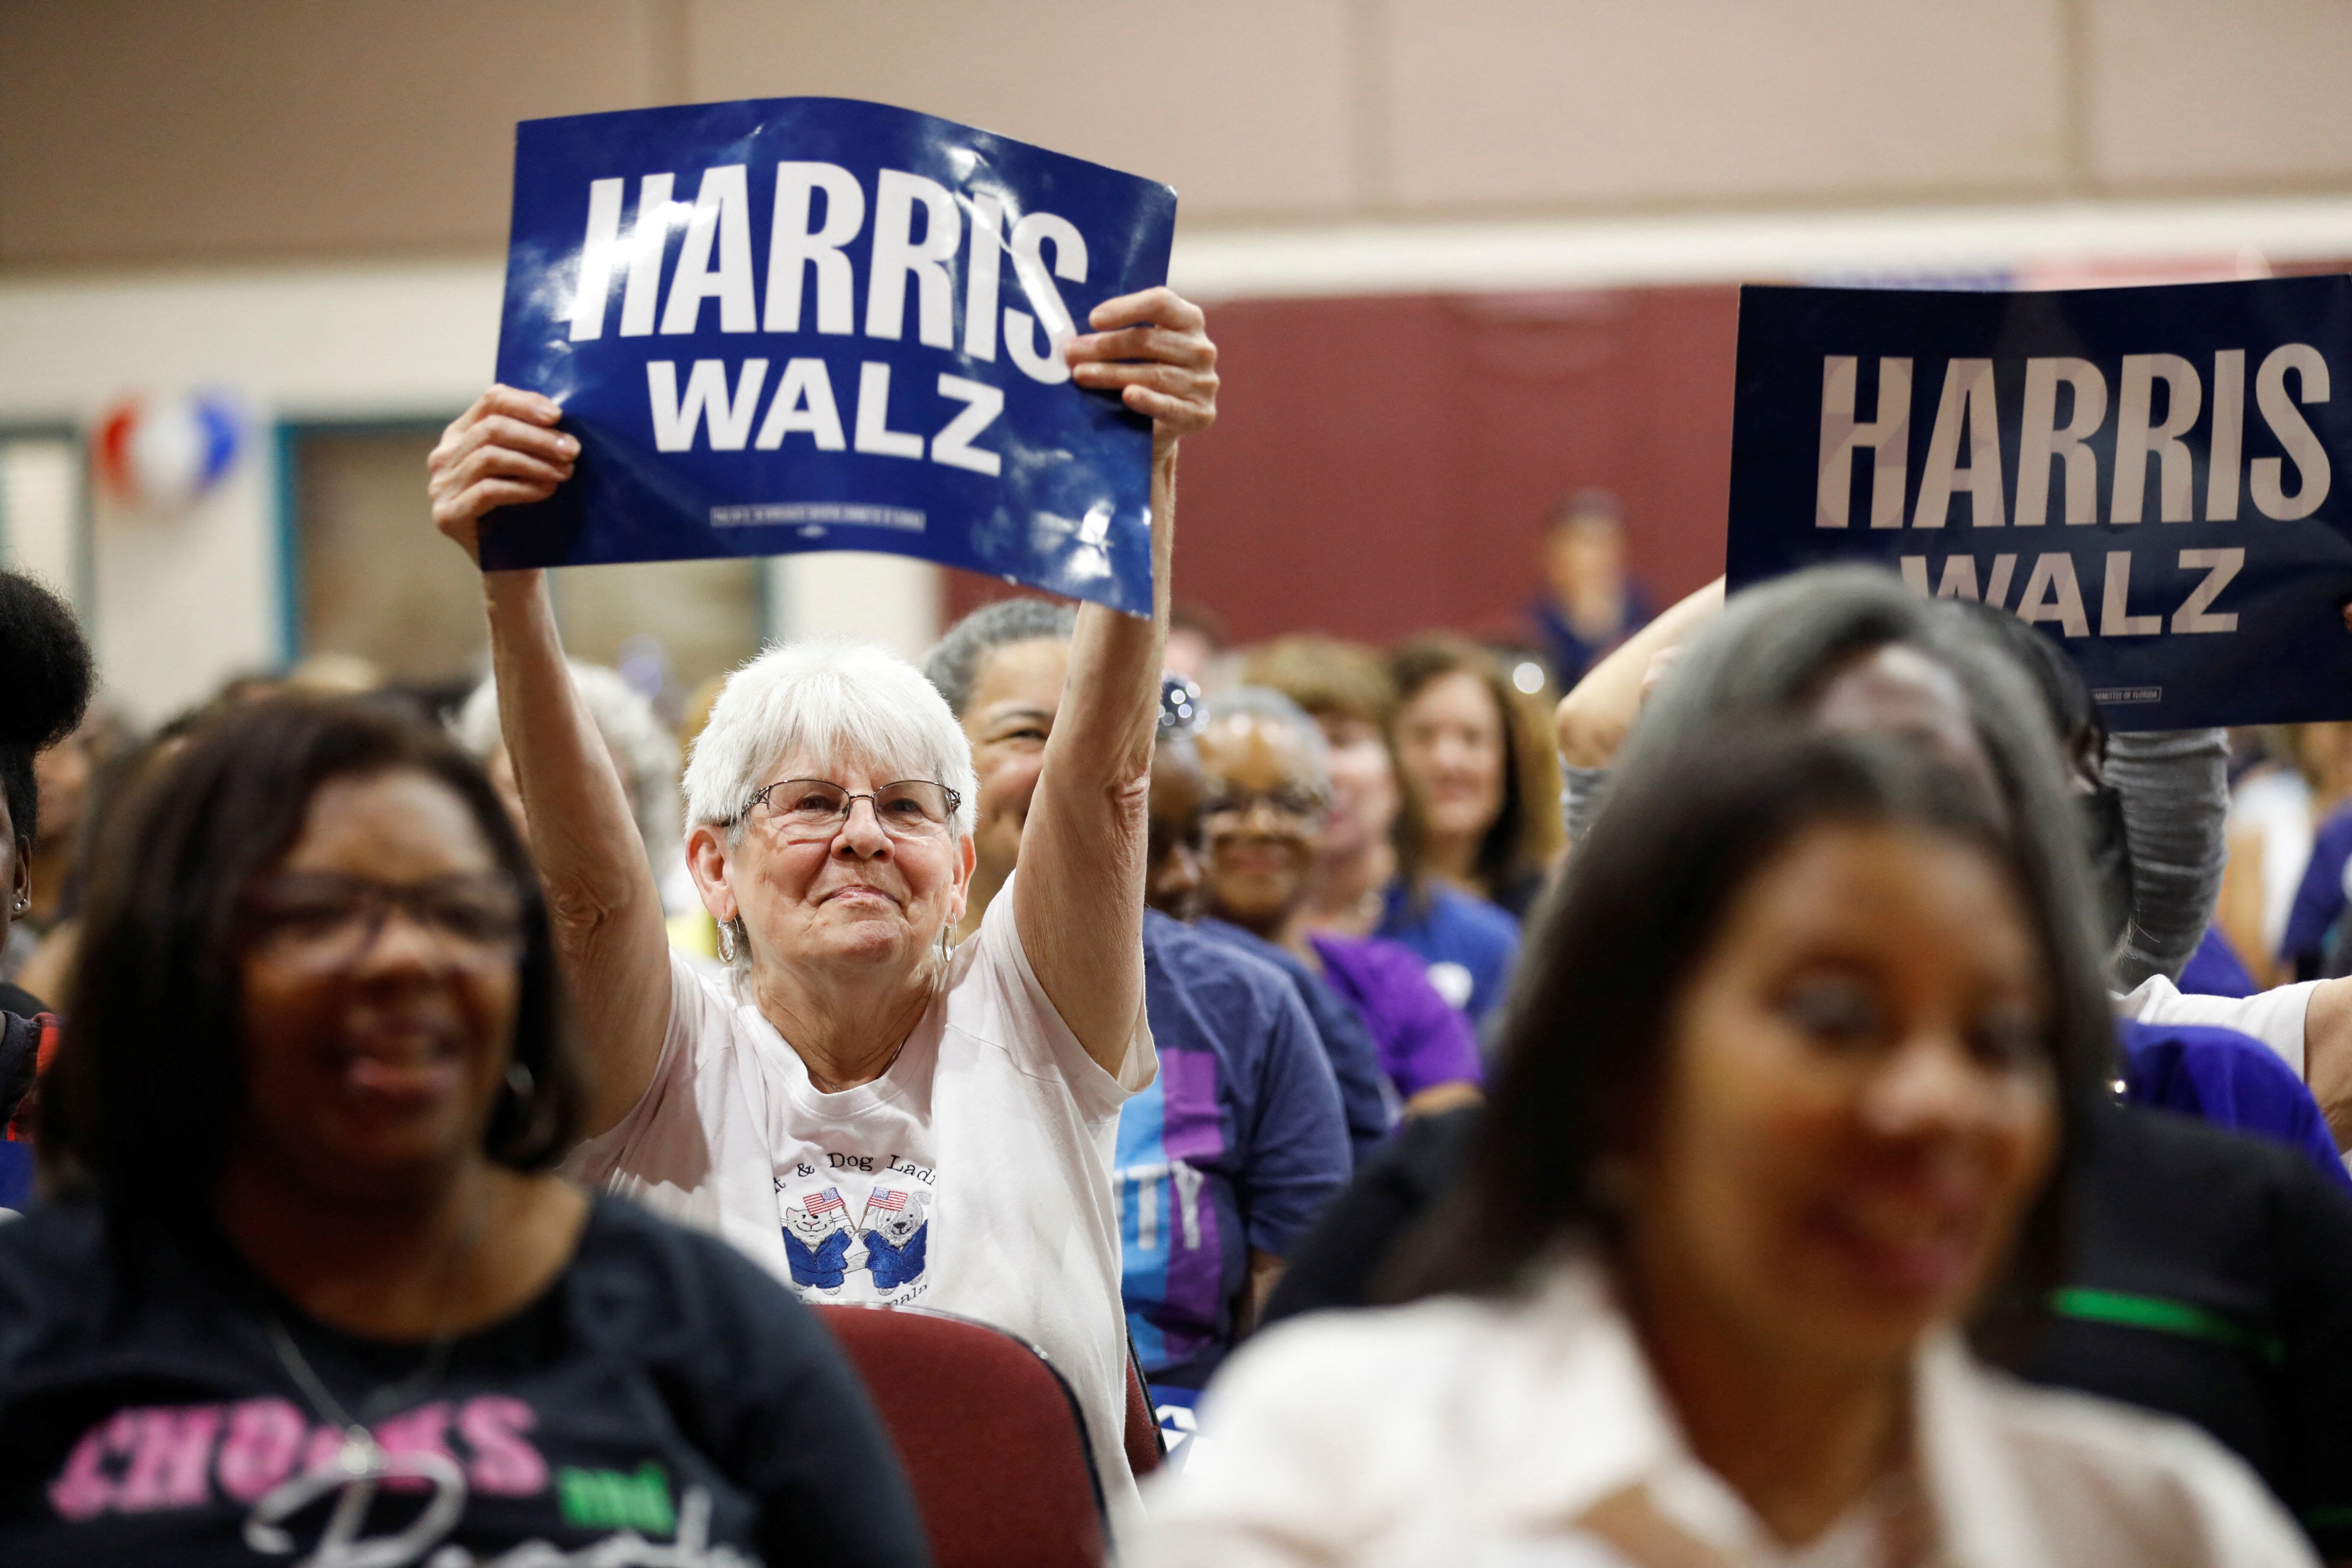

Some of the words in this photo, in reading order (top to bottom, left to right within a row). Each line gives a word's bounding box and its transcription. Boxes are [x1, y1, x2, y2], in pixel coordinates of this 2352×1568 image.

[568, 161, 1088, 385] HARRIS
[647, 358, 1004, 477] WALZ
[1815, 343, 2331, 529] HARRIS
[1900, 547, 2246, 638] WALZ
[797, 1163, 815, 1177] &
[827, 1152, 874, 1172] Dog
